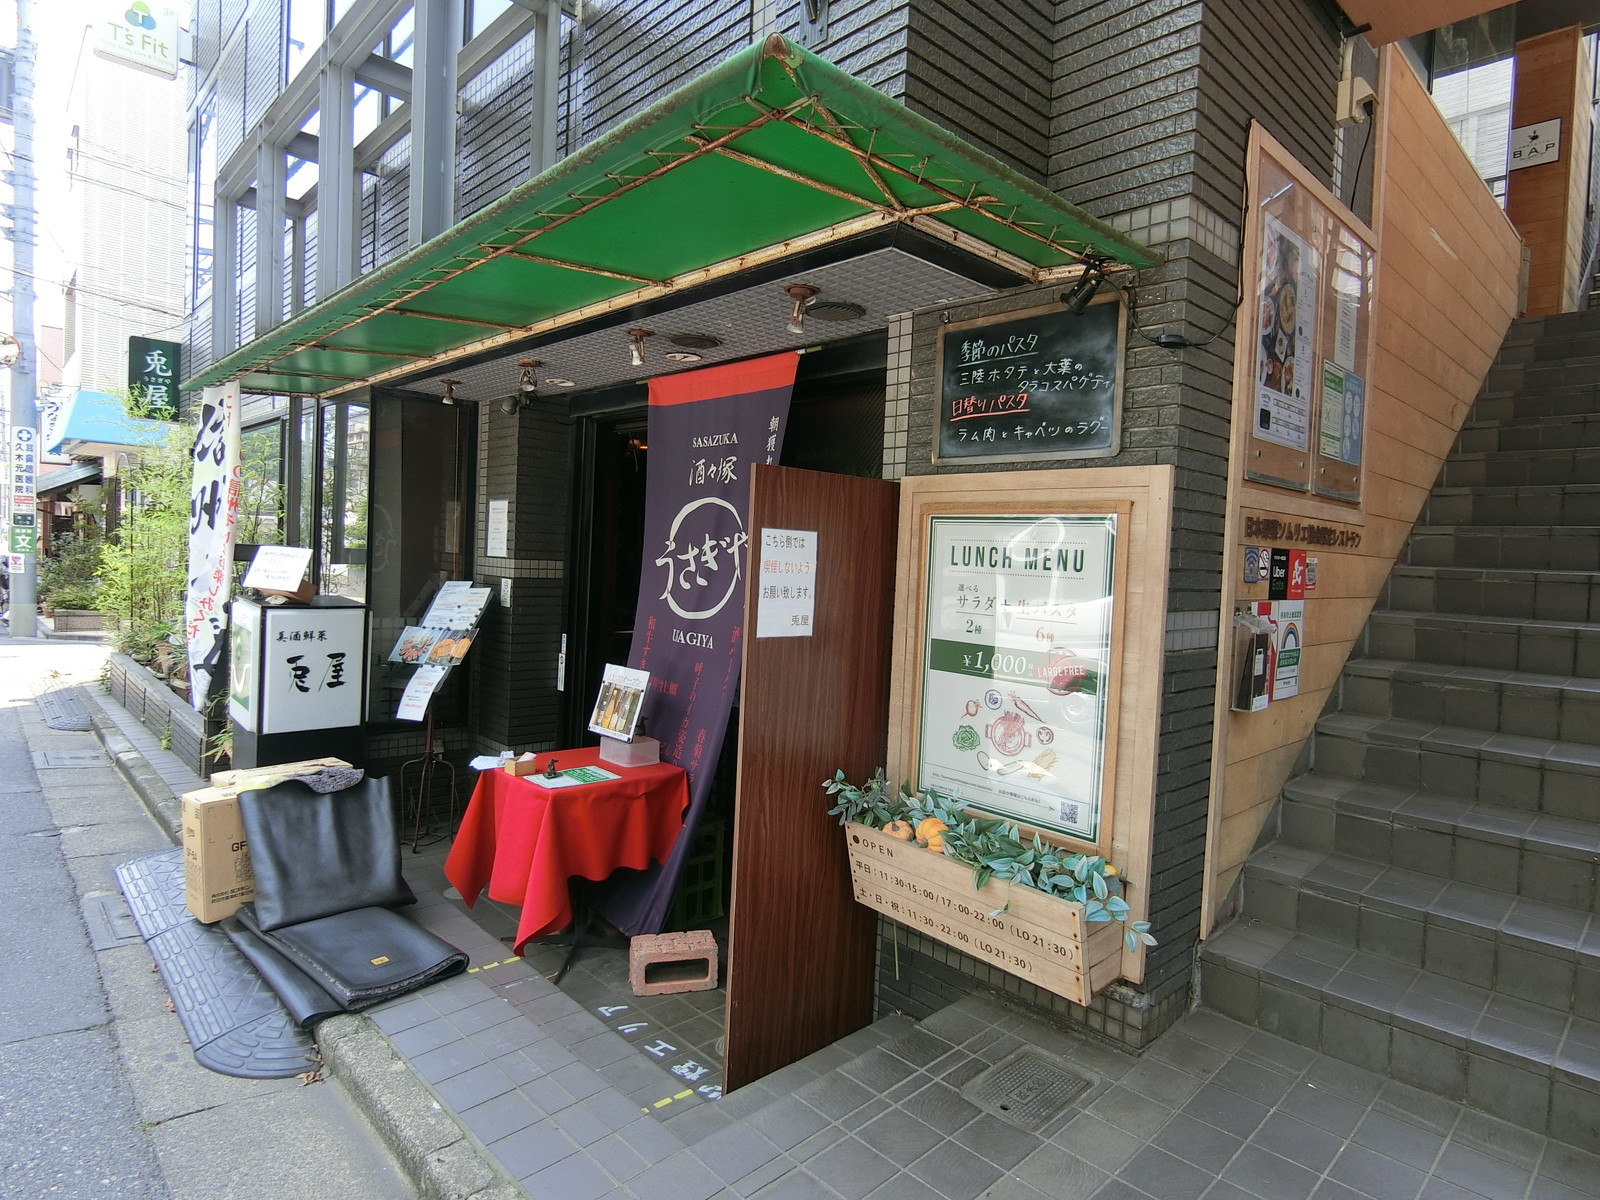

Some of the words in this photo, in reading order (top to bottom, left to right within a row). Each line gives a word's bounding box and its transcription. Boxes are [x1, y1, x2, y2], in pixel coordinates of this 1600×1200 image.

[142, 33, 169, 58] Fit
[961, 334, 1039, 362] 季節のパスタ
[1017, 373, 1114, 394] タラコスパゲティ
[952, 393, 1029, 417] 日替りパスタ
[692, 432, 738, 448] SASAZUKA
[15, 442, 24, 494] 久木元医院
[15, 535, 32, 549] 文
[765, 534, 805, 549] こちら側では
[763, 560, 810, 574] 喫煙しないよう
[951, 545, 1012, 569] LUNCH
[1024, 547, 1085, 573] MENU
[1273, 566, 1286, 578] Uber
[1272, 579, 1285, 591] Eats
[957, 595, 997, 611] サラダ
[965, 619, 983, 635] 2種
[963, 650, 1027, 675] ¥1,000
[1063, 664, 1085, 676] FREE
[862, 838, 894, 858] OPEN
